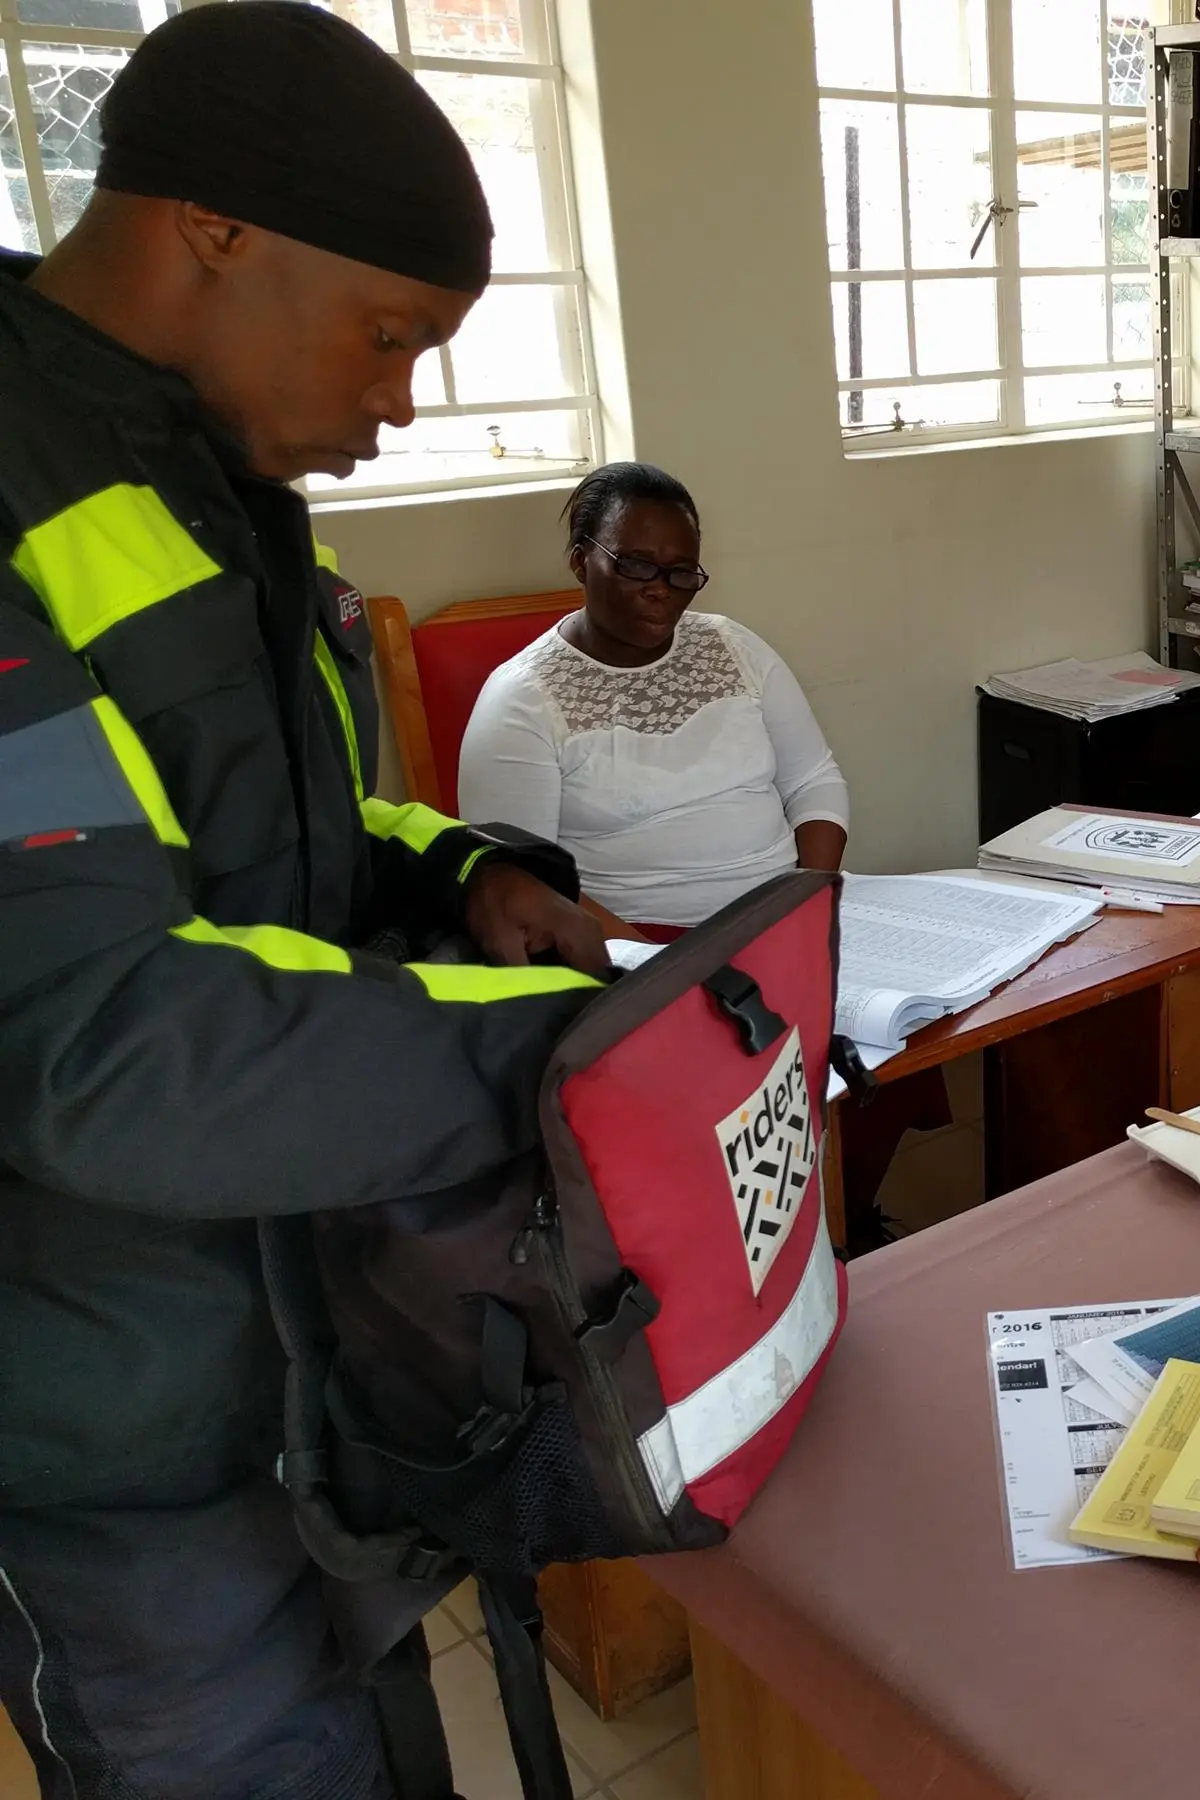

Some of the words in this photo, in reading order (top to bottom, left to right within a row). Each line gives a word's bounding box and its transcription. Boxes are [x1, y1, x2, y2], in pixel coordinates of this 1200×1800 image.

[725, 1049, 804, 1177] riders
[1106, 1310, 1125, 1318] 2016
[1002, 1321, 1043, 1333] 2016
